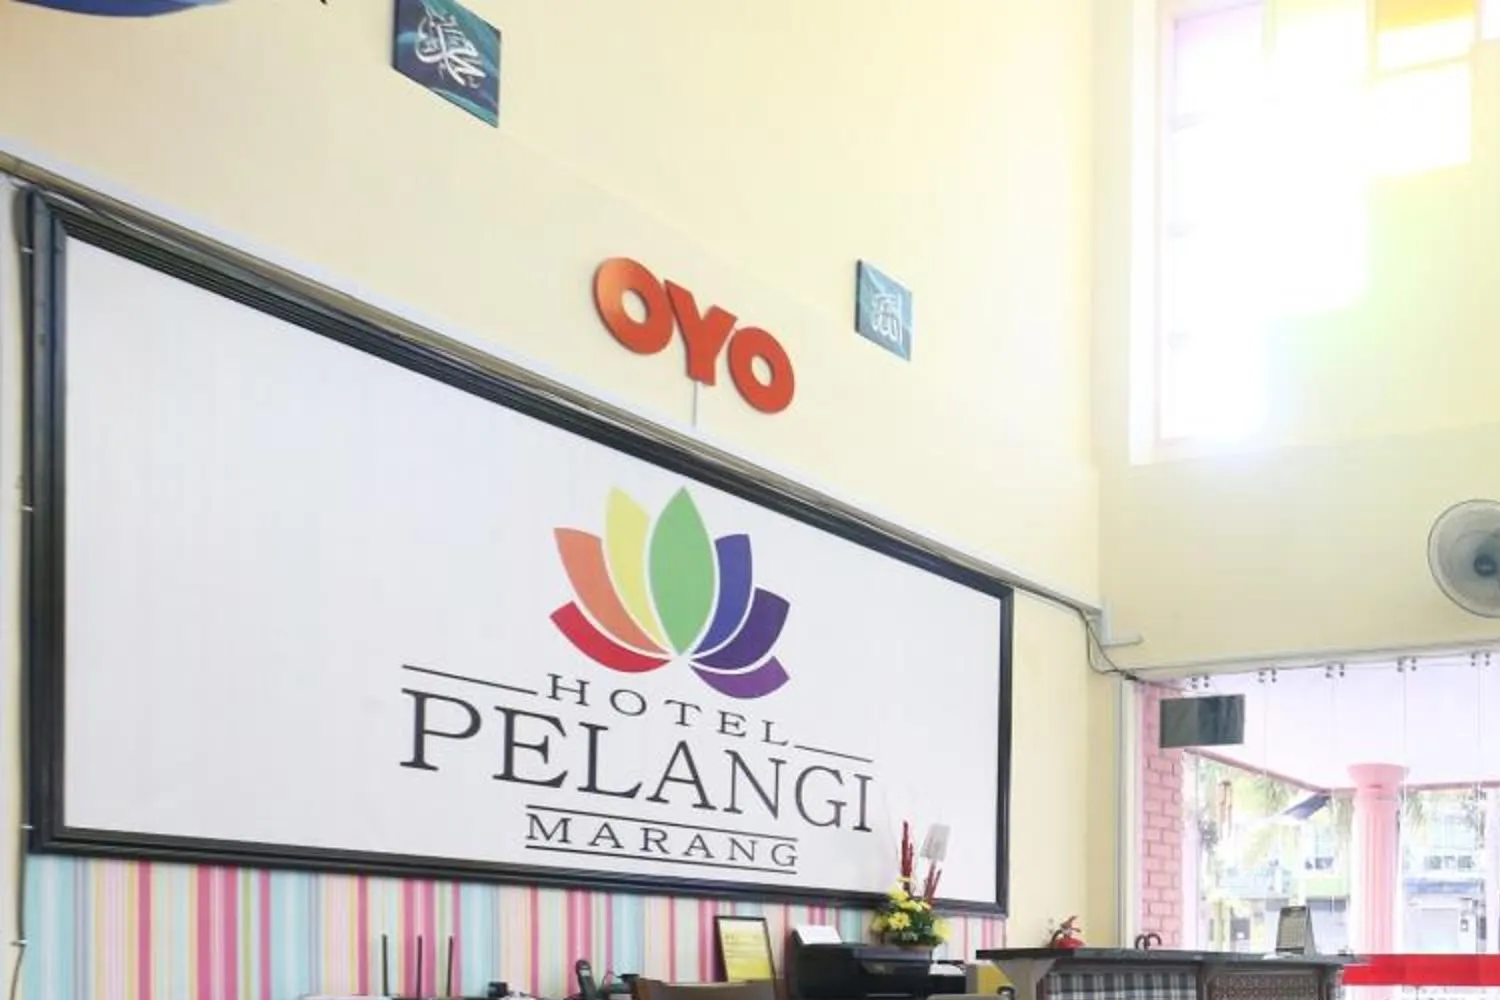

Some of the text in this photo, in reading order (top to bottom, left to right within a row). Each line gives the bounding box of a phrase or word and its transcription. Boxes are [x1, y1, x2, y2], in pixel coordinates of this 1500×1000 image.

[592, 256, 796, 415] OYO
[399, 687, 874, 833] PELANGI
[546, 672, 790, 748] HOTEL
[525, 812, 799, 868] MARANG
